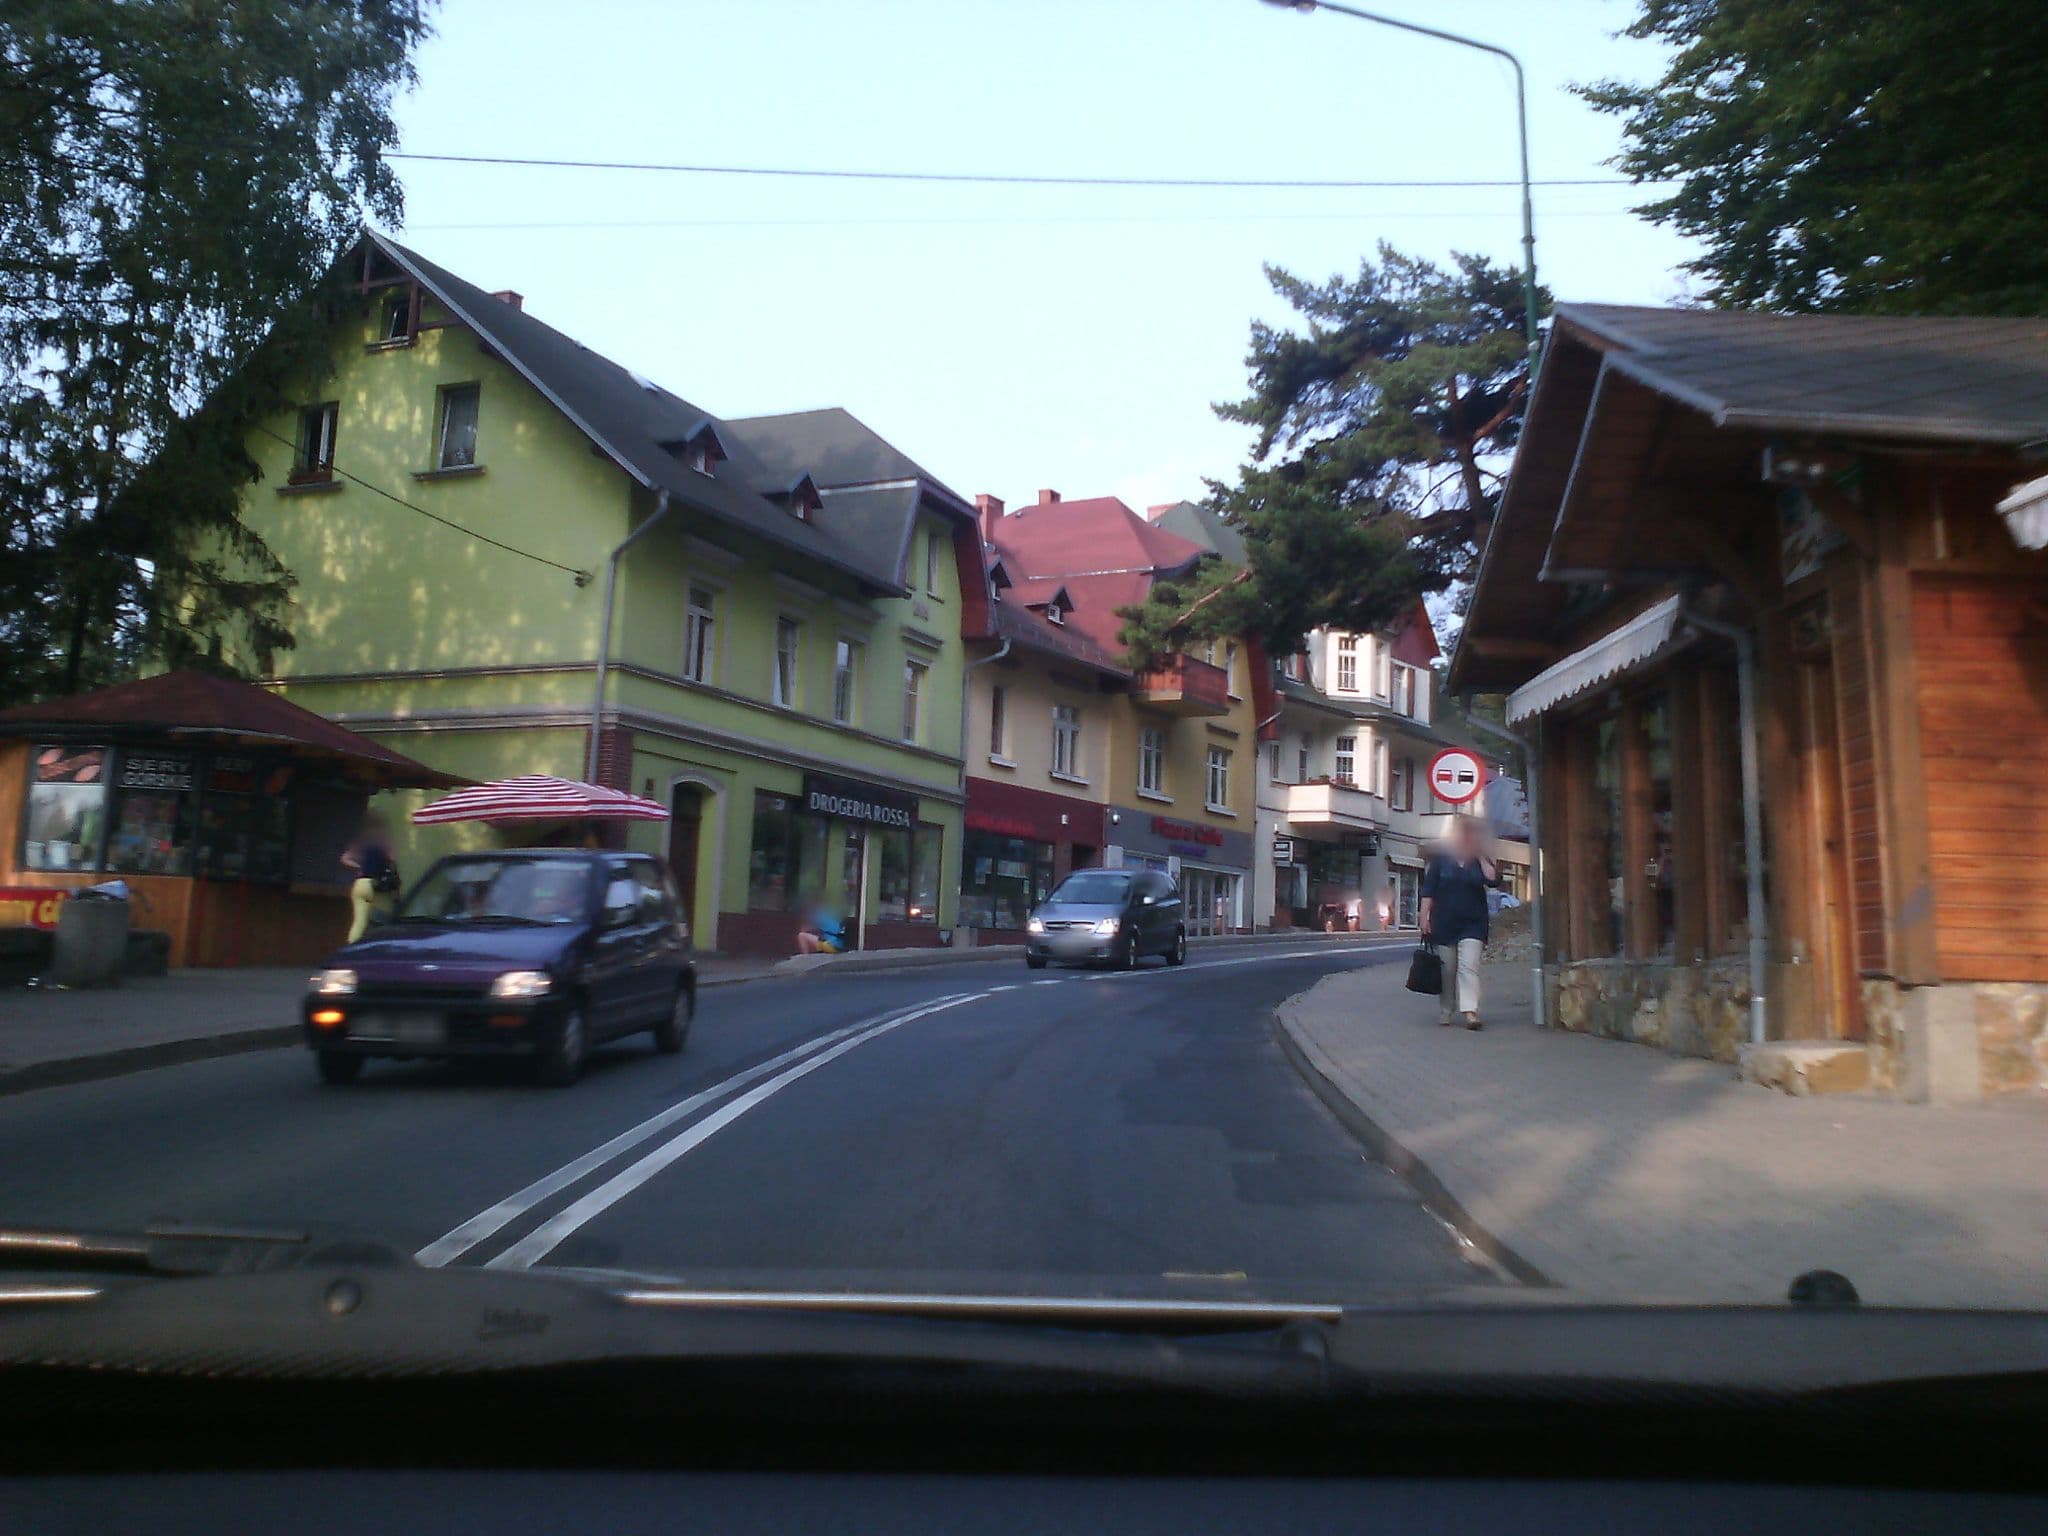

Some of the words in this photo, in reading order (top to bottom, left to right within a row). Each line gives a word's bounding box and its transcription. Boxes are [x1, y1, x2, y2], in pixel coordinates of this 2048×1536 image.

[126, 758, 191, 772] SERY
[810, 792, 872, 820] DROGERIA
[873, 804, 910, 827] ROSSA
